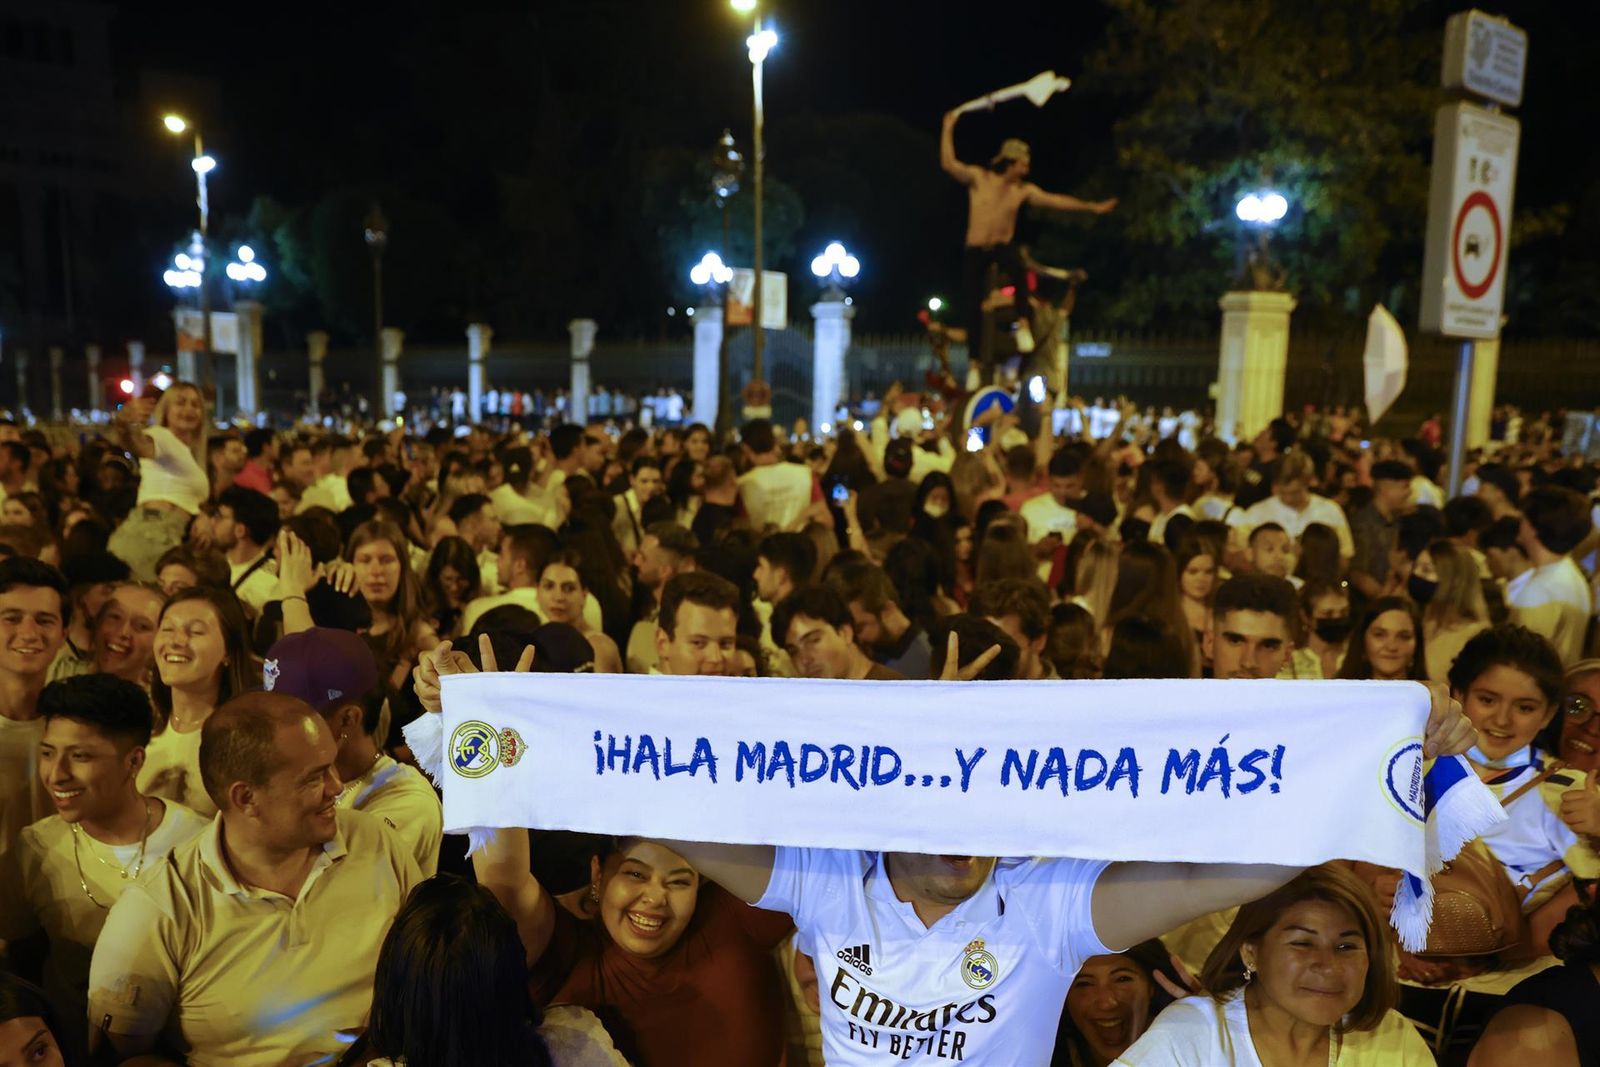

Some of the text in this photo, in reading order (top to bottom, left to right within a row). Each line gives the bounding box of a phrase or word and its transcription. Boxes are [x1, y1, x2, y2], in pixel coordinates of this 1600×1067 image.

[593, 729, 719, 784] ¡HALA
[1000, 746, 1144, 799] NADA
[1160, 732, 1287, 800] MÁS!
[1409, 756, 1422, 804] MADRIDISTA
[836, 949, 874, 977] adidas
[830, 966, 998, 1033] Emirates
[848, 1020, 968, 1062] FLY BETTER
